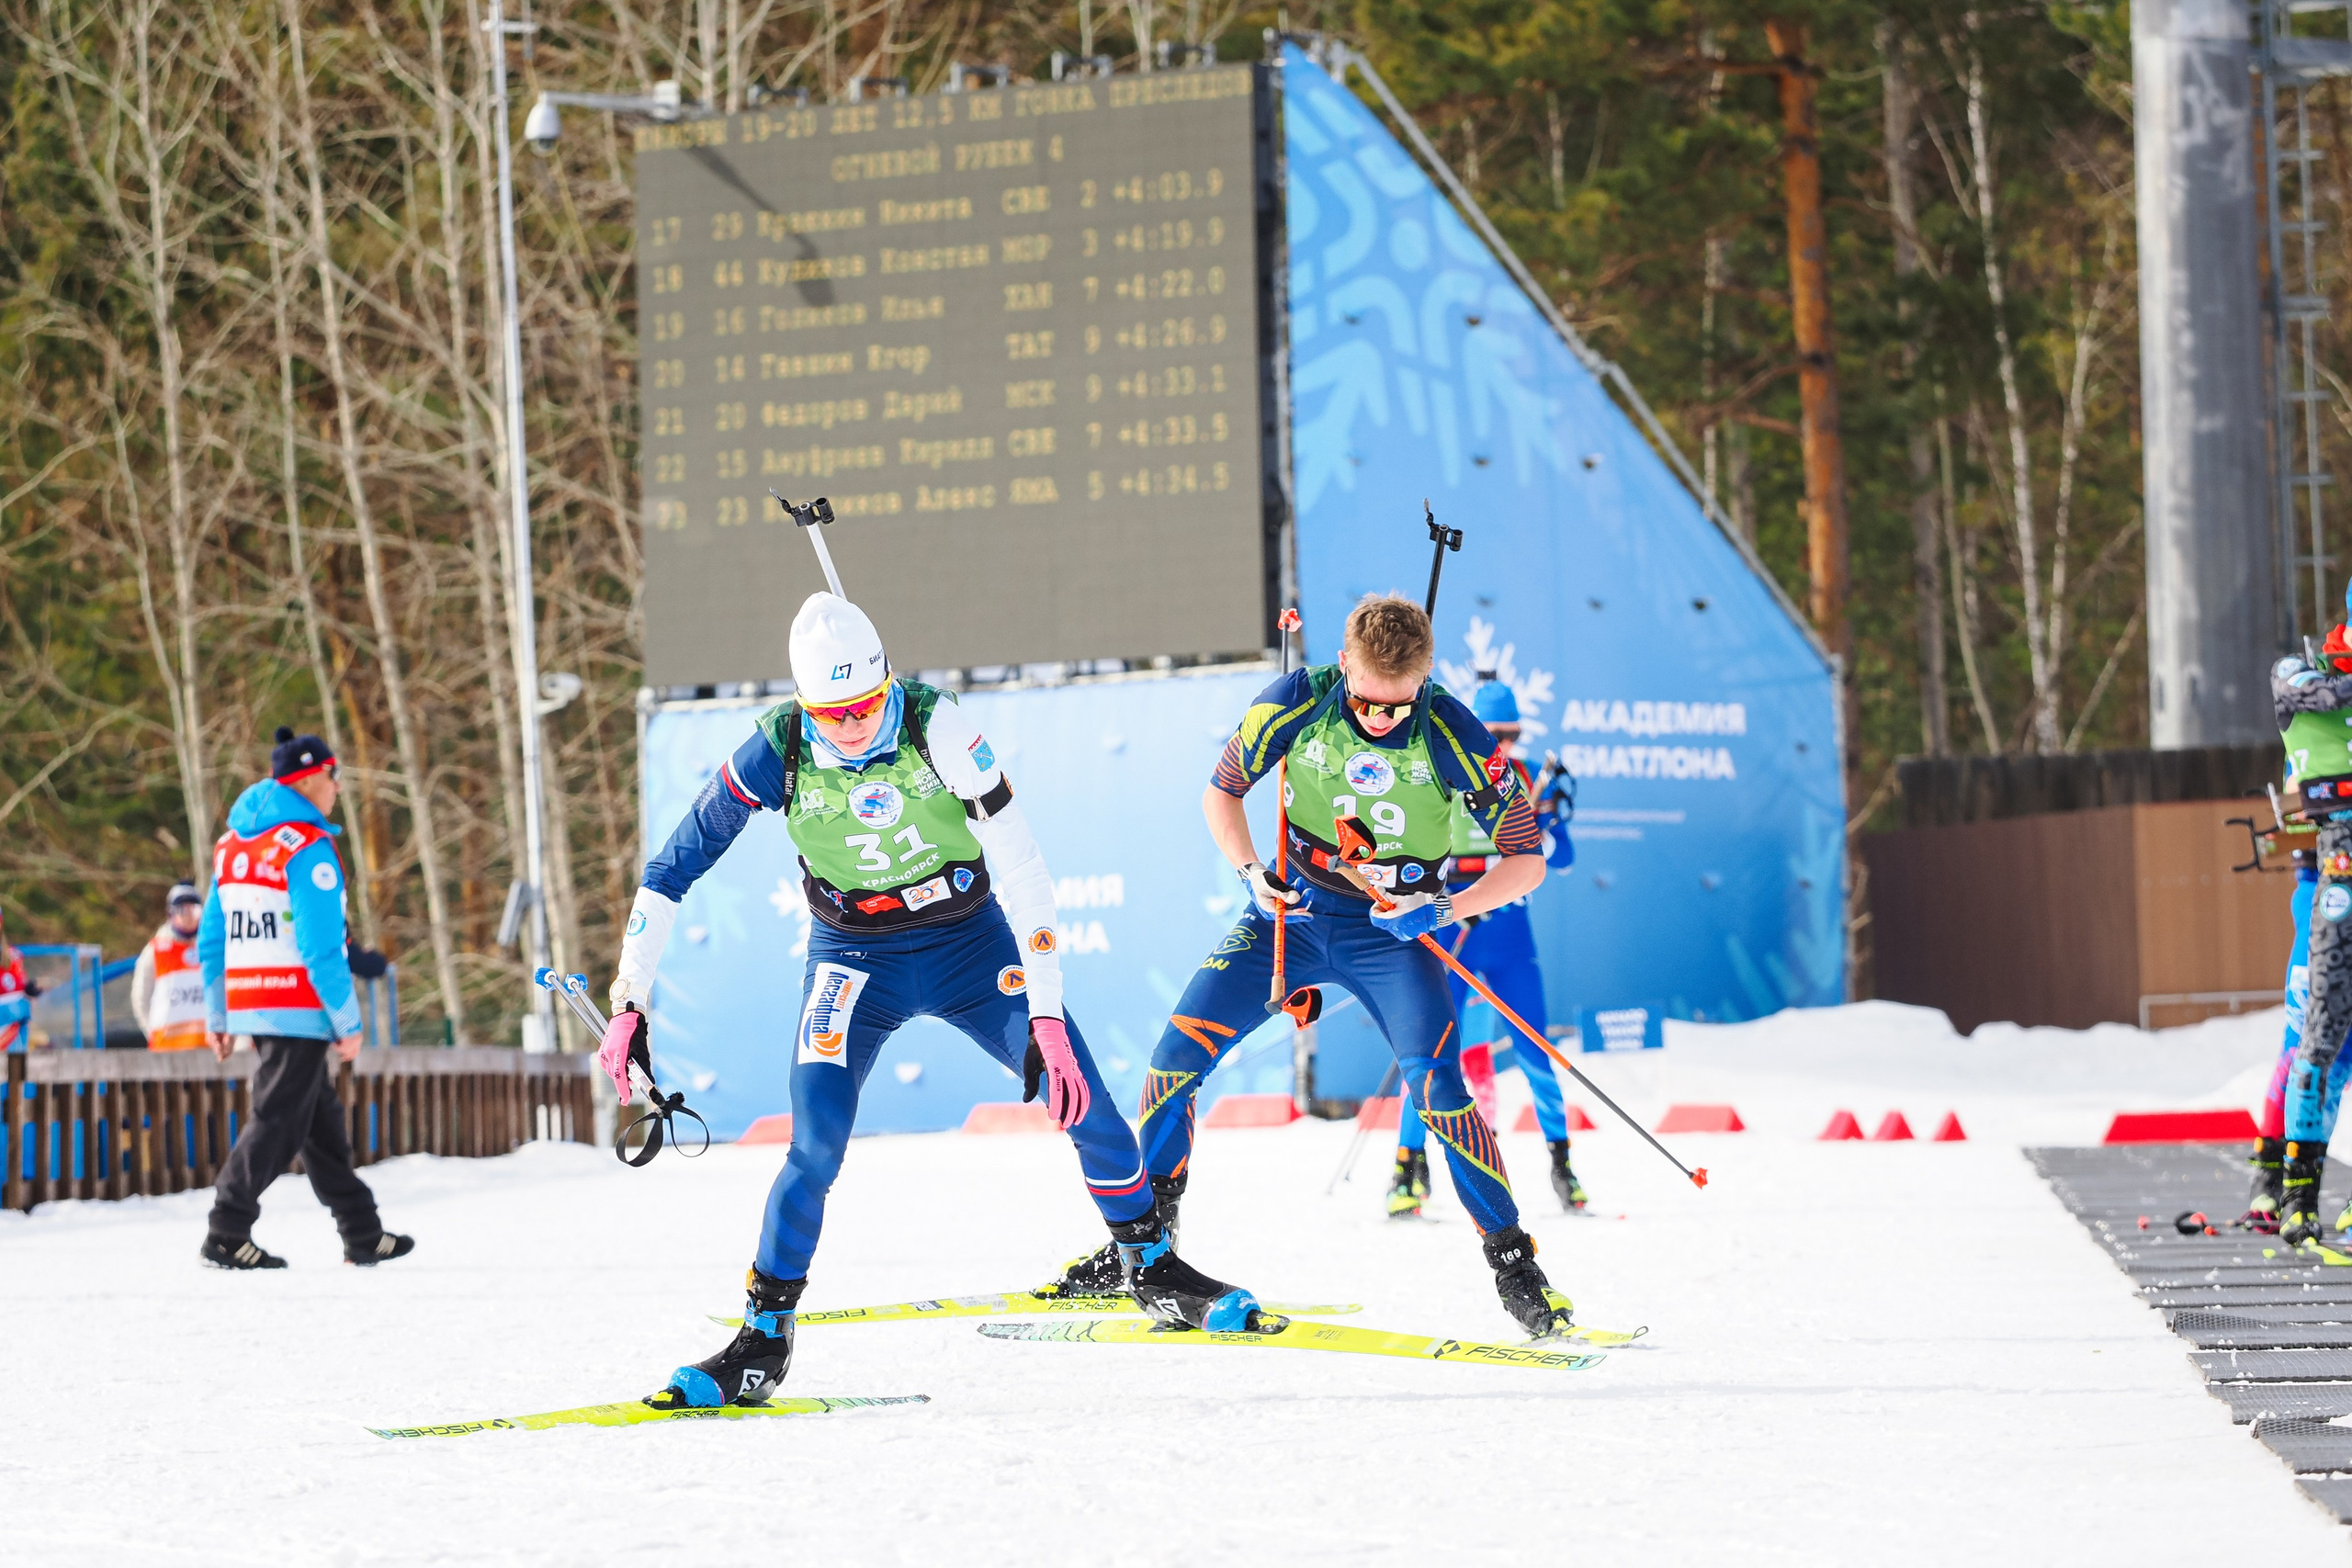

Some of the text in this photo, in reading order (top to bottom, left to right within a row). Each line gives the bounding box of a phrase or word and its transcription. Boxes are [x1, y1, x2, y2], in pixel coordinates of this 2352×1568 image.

[741, 109, 818, 143] 19-20
[968, 95, 1001, 122] КМ
[1015, 84, 1096, 117] ГОНКА
[831, 134, 1064, 182] ОГНЕВОЙ РУБЕЖ 4
[651, 216, 682, 246] 17
[879, 197, 973, 226] Никита
[1080, 179, 1097, 209] 2
[1113, 167, 1224, 204] +4:03.9
[713, 258, 743, 289] 44
[1081, 228, 1098, 258] 3
[1114, 216, 1225, 254] +4:19.9
[654, 310, 684, 342] 19
[714, 305, 745, 336] 16
[1082, 276, 1099, 303] 7
[1114, 265, 1226, 301] +4:22.0
[654, 358, 685, 389] 20
[715, 354, 745, 384] 14
[867, 344, 932, 376] Егор
[1004, 330, 1055, 360] ТАТ
[1084, 324, 1102, 355] 9
[1115, 314, 1227, 350] +4:26.9
[654, 406, 685, 436] 21
[716, 401, 747, 431] 20
[1005, 378, 1056, 409] МСК
[1086, 373, 1102, 403] 9
[1117, 364, 1227, 399] +4:33.1
[656, 453, 686, 484] 22
[717, 448, 748, 479] 15
[1086, 422, 1102, 448] 7
[1117, 412, 1228, 447] +4:33.5
[718, 496, 748, 527] 23
[1088, 470, 1102, 502] 5
[1119, 461, 1229, 497] +4:34.5
[1561, 699, 1747, 739] АКАДЕМИЯ
[1562, 744, 1736, 780] БИАТЛОНА
[785, 771, 796, 796] biatar
[1332, 795, 1407, 838] 19
[843, 823, 939, 873] 31
[862, 852, 941, 888] КРАСНОЯРСК
[231, 910, 277, 943] ДЬЯ
[1500, 1247, 1521, 1262] 169
[796, 1308, 866, 1322] FISCH
[1048, 1302, 1118, 1311] FISCHER
[1210, 1334, 1263, 1343] FISCHER
[1465, 1346, 1581, 1368] FISCHER
[393, 1422, 484, 1438] FISCHER
[671, 1409, 720, 1420] FISCHER
